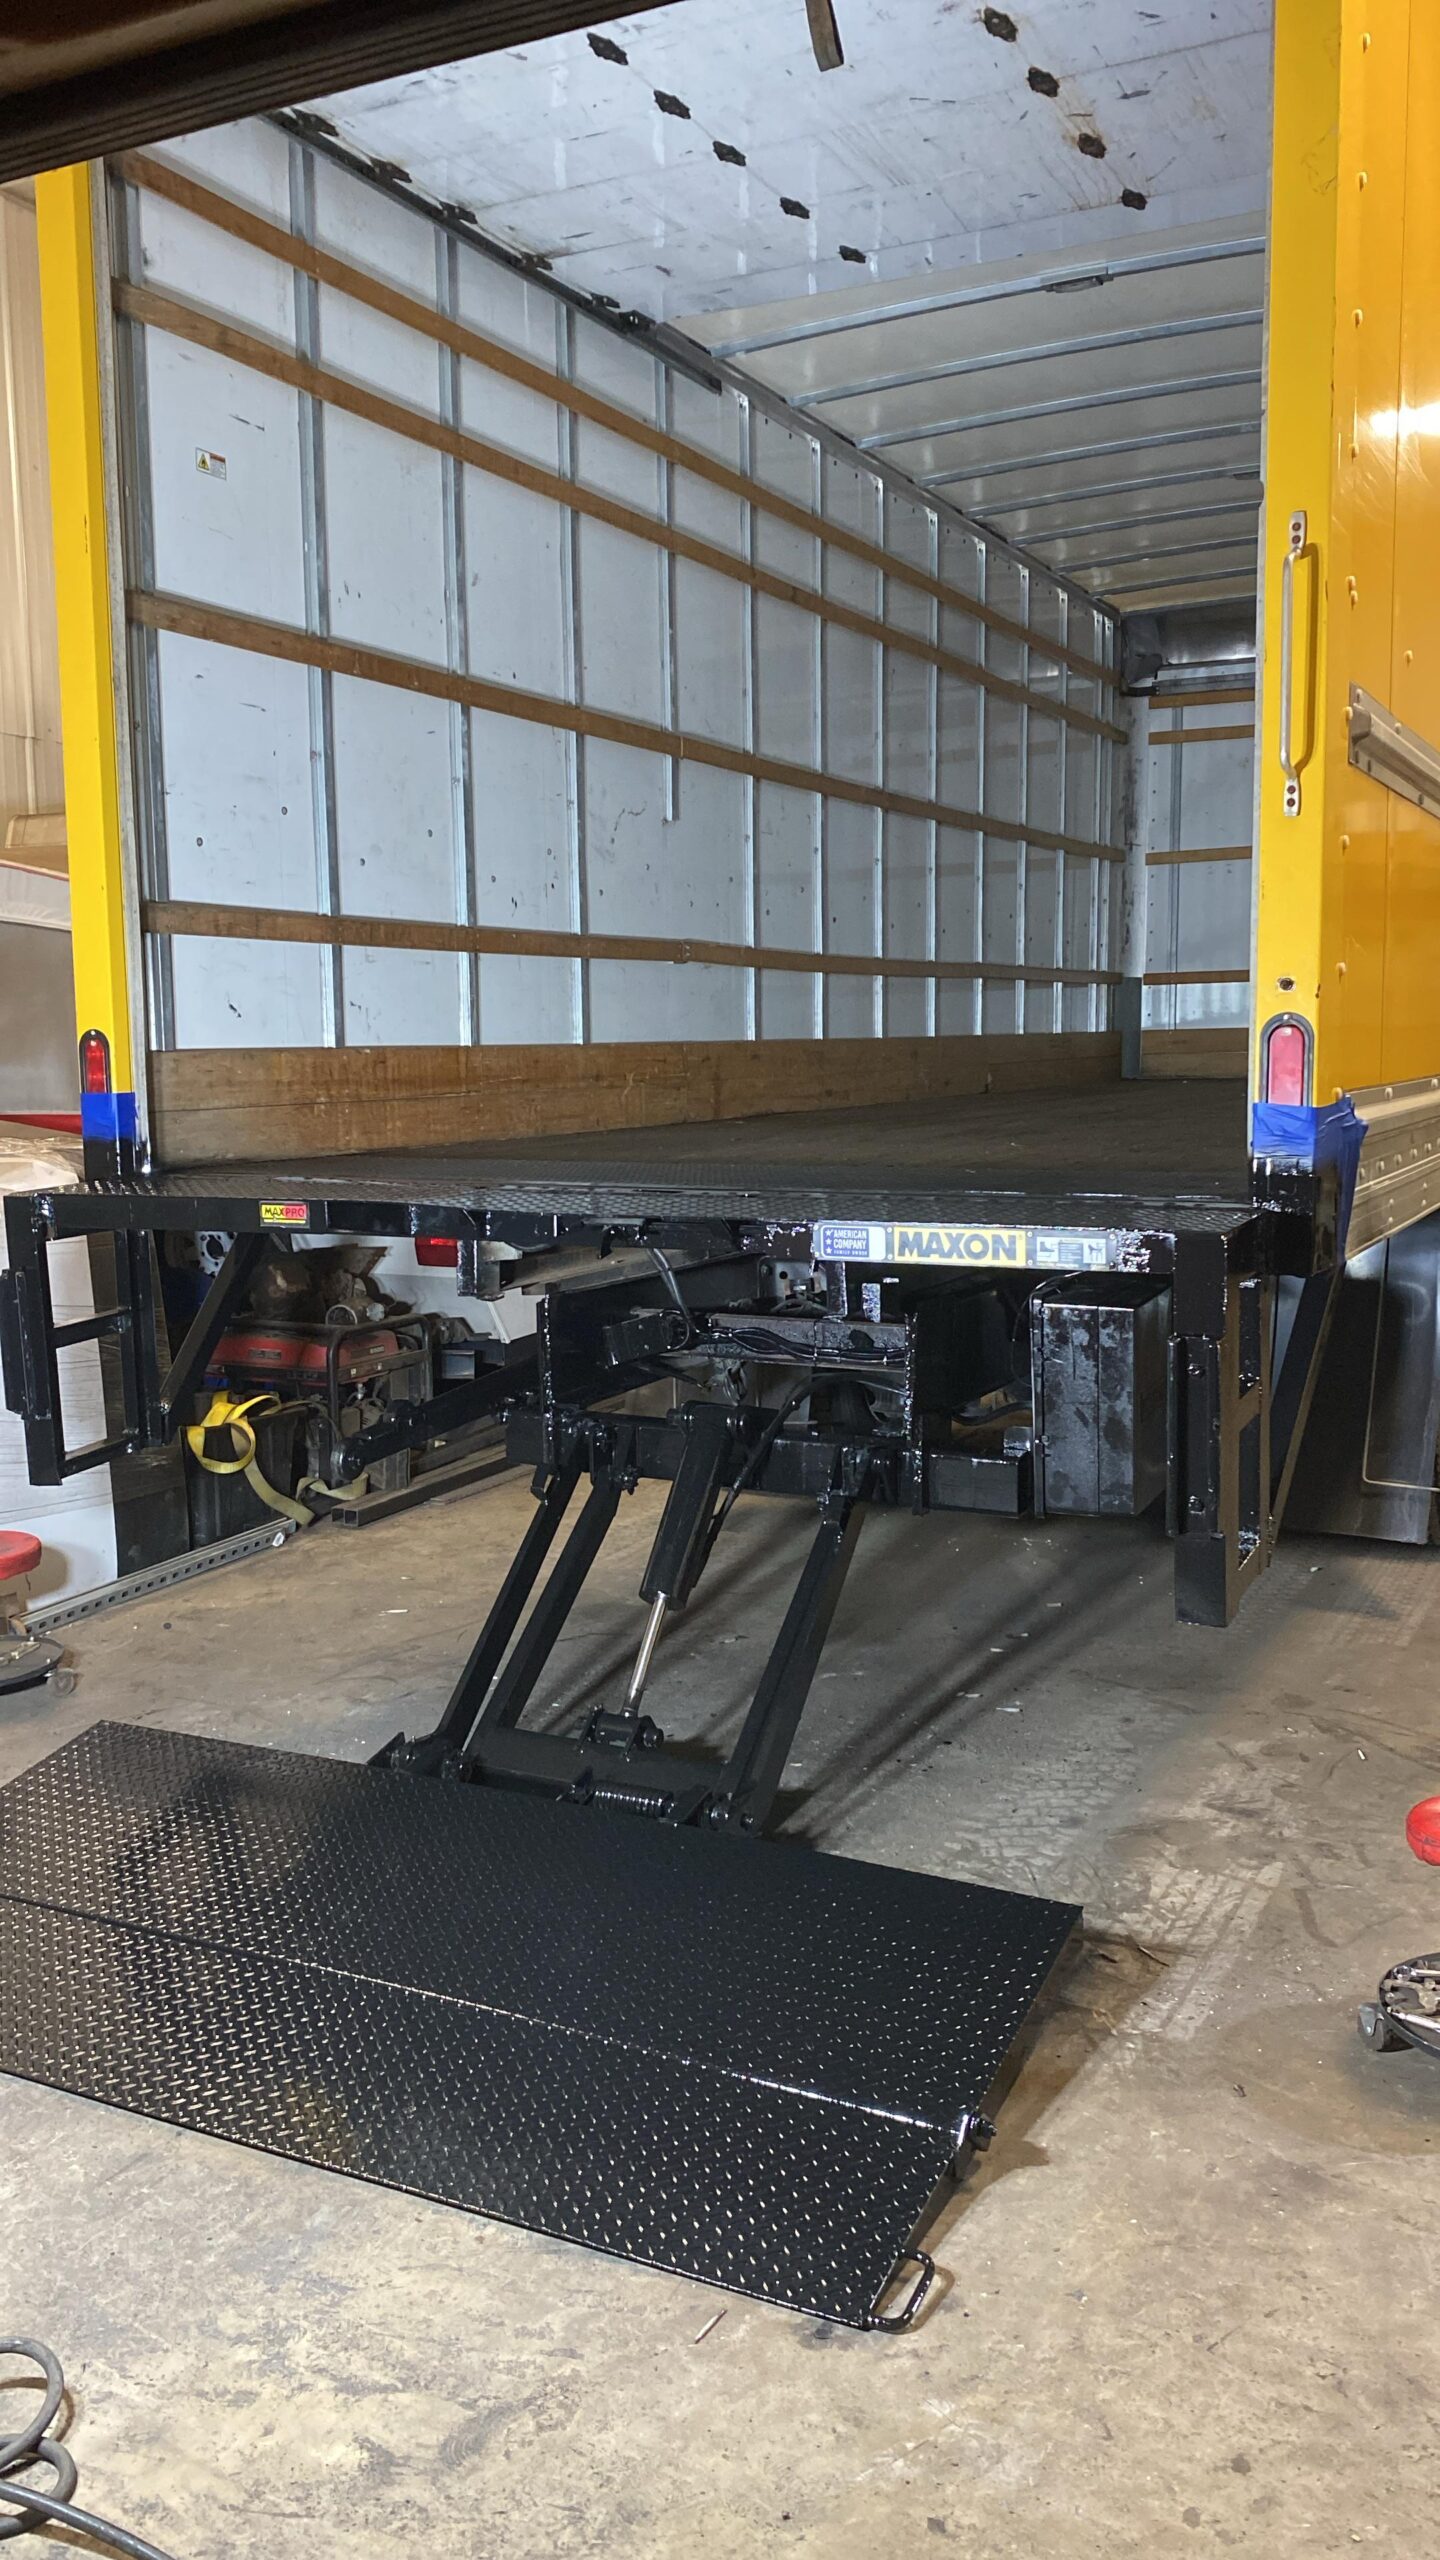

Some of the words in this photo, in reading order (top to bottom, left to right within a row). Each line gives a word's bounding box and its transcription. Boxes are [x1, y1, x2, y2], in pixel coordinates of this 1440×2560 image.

[264, 1207, 304, 1217] MAXPRO
[834, 1229, 867, 1239] AMERICAN
[834, 1239, 866, 1249] COMPANY
[897, 1231, 1016, 1260] MAXON
